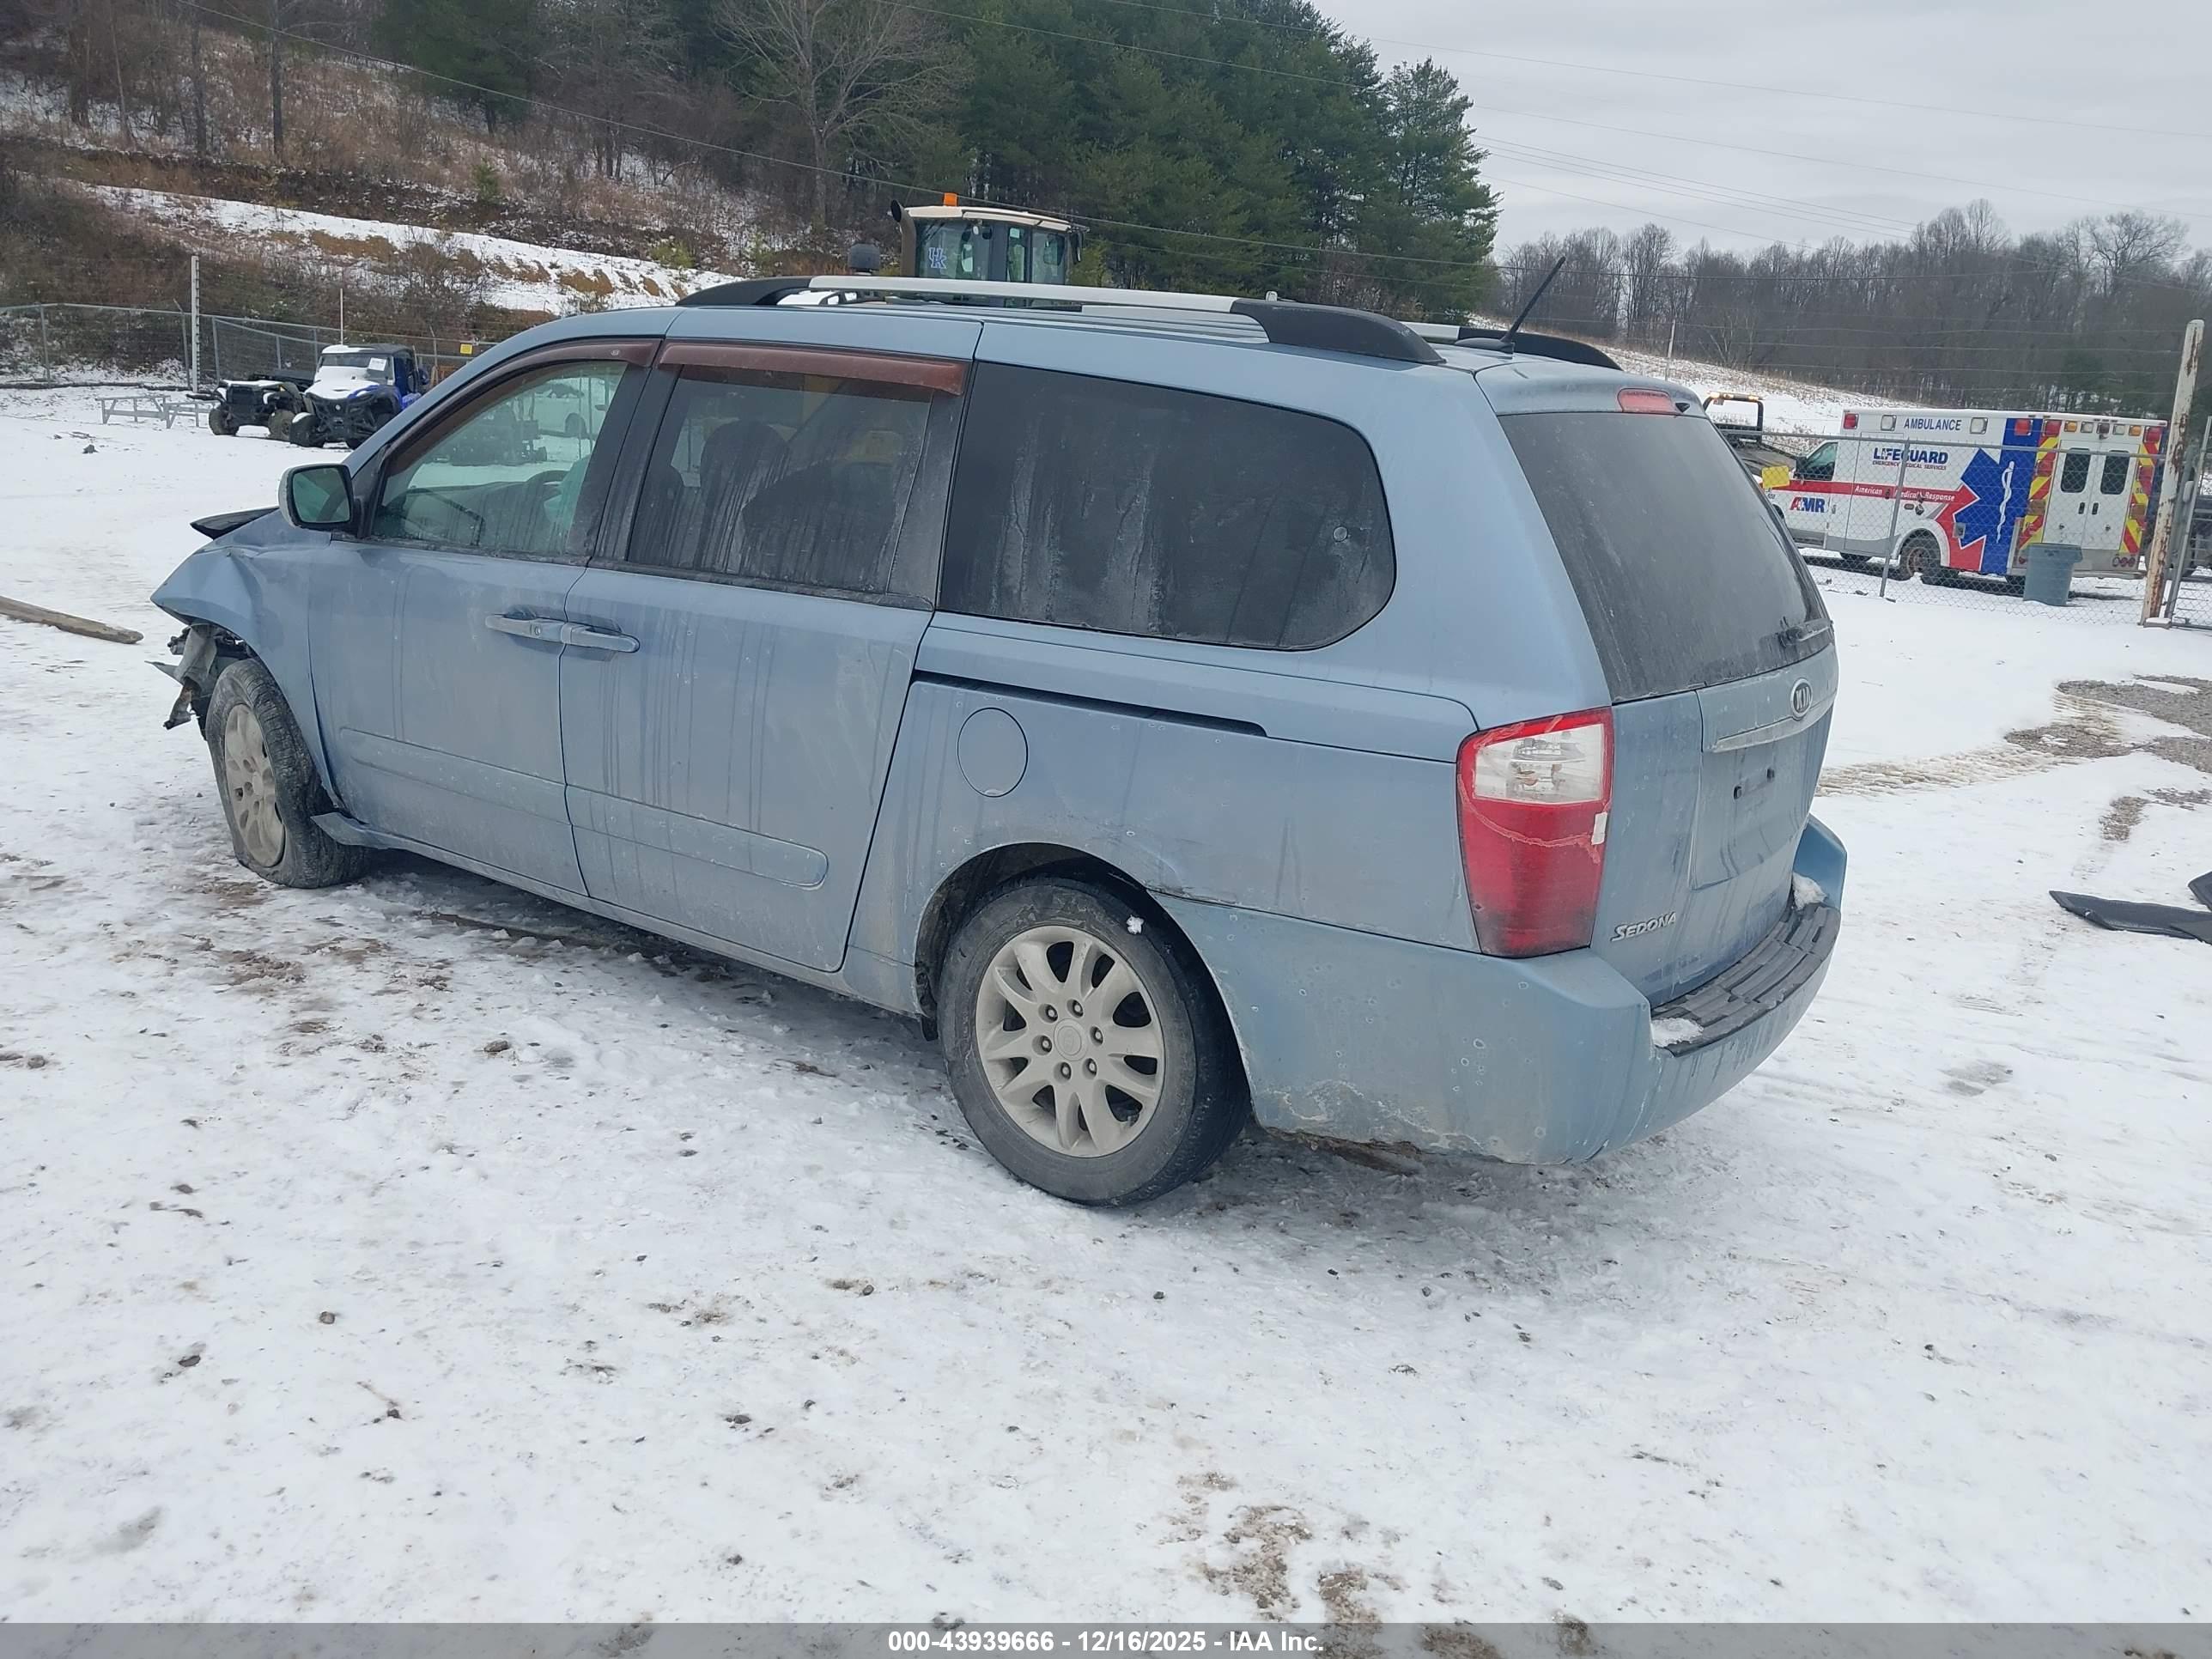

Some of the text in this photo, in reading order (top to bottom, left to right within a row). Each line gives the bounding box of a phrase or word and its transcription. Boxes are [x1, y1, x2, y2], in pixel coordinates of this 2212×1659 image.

[1904, 417, 1962, 431] AMBULANCE
[1854, 485, 1883, 495] American
[1925, 491, 1955, 501] Response
[1790, 496, 1826, 513] AMR
[1609, 911, 1677, 942] SEDONA
